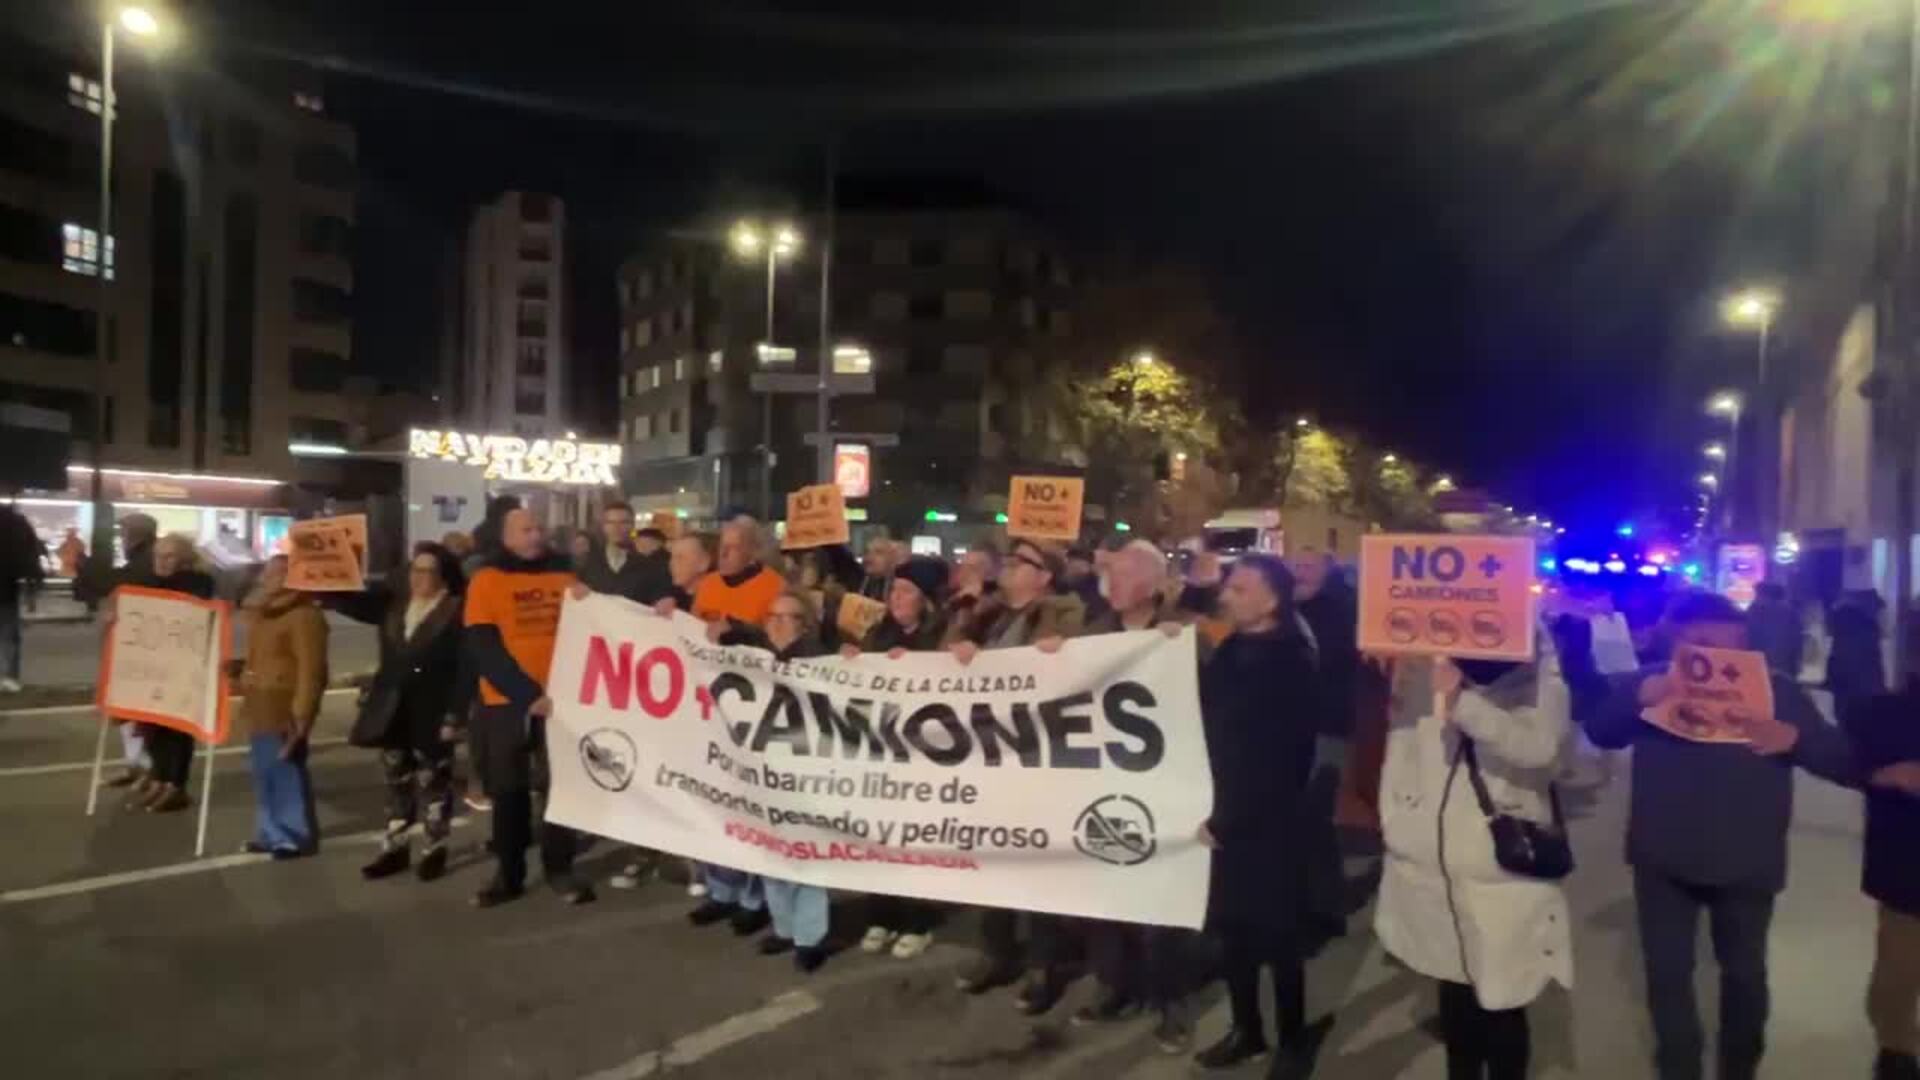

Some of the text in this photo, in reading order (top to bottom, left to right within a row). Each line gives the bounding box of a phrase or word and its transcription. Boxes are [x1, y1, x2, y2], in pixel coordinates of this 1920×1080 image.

[1024, 483, 1056, 502] NO
[1392, 545, 1503, 582] NO +
[1389, 585, 1499, 602] CAMIONES
[579, 635, 685, 720] NO
[871, 675, 900, 692] DE
[906, 677, 932, 693] LA
[938, 675, 1037, 693] CALZADA
[710, 672, 1166, 772] CAMIONES
[763, 764, 855, 798] barrio
[862, 771, 932, 803] libre
[940, 778, 978, 804] de
[655, 763, 1050, 851] transporte pesado y peligroso
